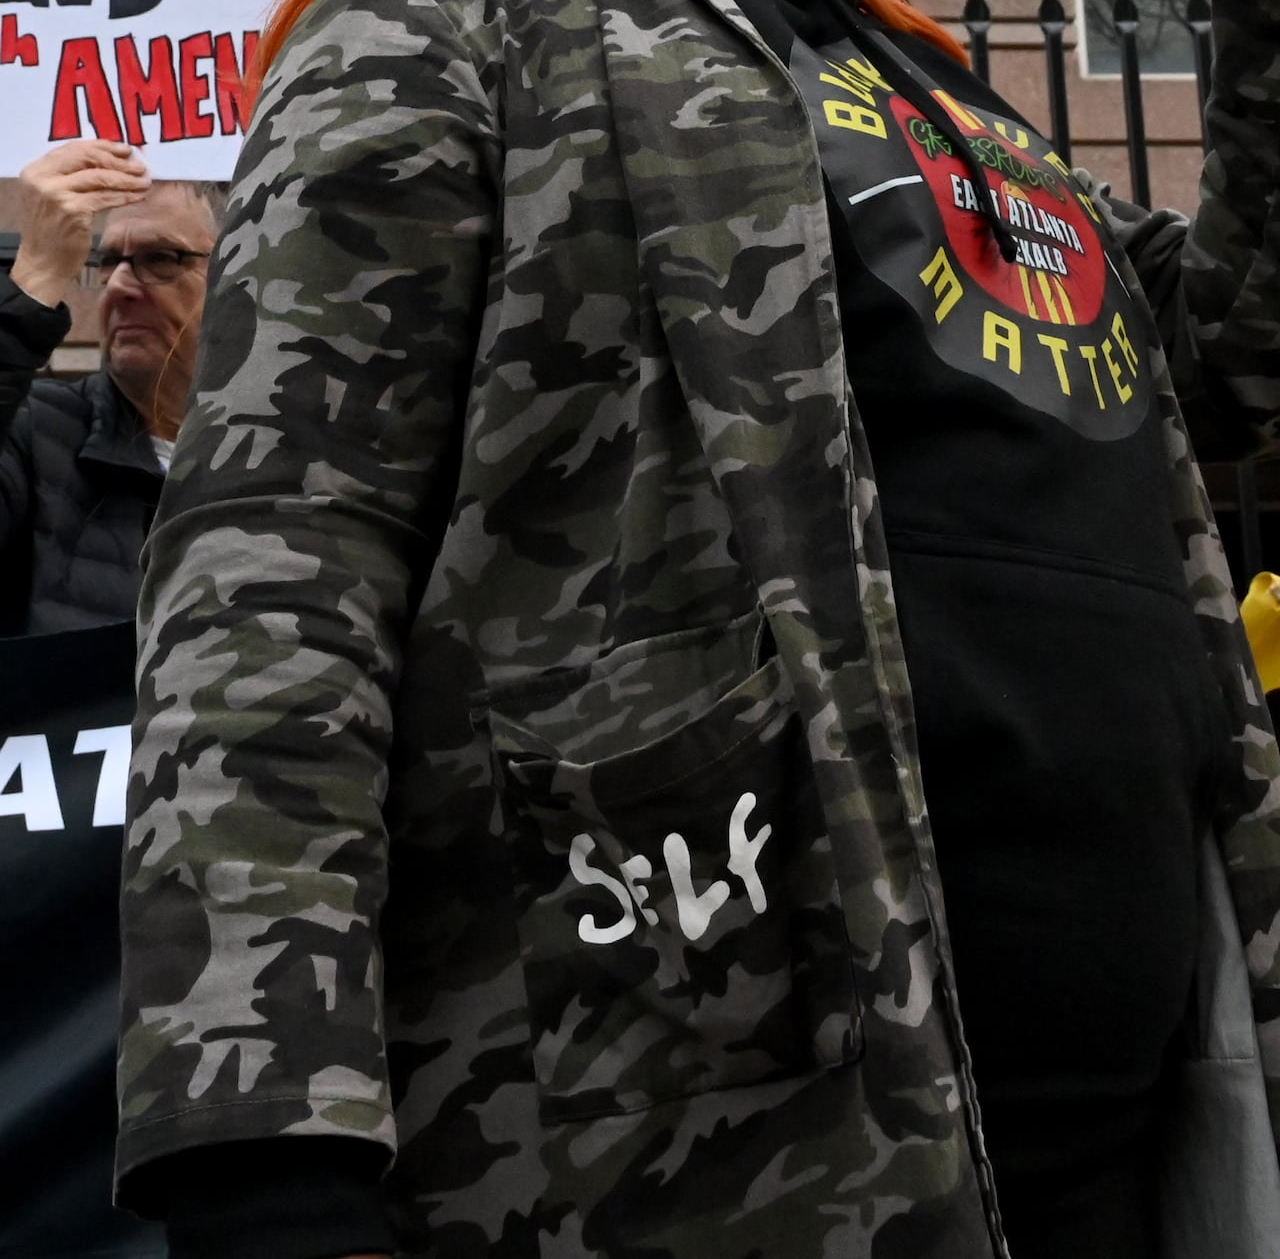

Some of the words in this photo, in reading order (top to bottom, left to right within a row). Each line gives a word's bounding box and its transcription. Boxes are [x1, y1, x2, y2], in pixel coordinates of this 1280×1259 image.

[950, 173, 1001, 219] EAT
[1007, 195, 1085, 255] ATLANTA
[1012, 236, 1068, 275] EKALB
[919, 246, 1140, 410] MATTER
[570, 792, 771, 944] SELF
